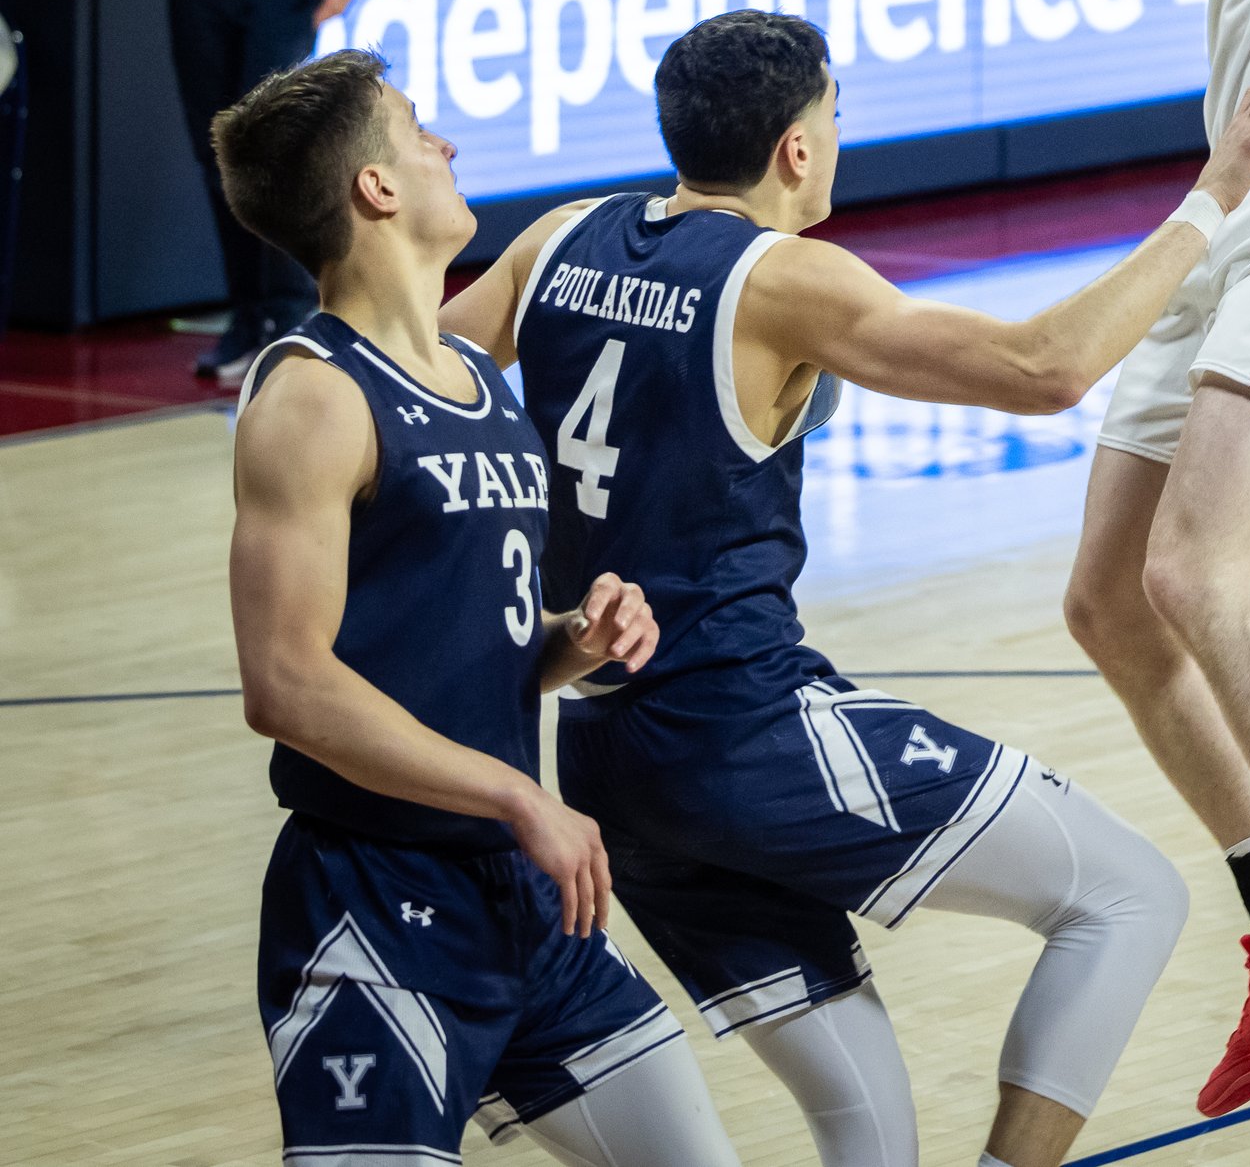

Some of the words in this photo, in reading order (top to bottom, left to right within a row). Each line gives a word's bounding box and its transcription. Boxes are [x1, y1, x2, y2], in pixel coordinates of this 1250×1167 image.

[540, 263, 702, 333] POULAKIDAS
[557, 338, 627, 520] 4
[502, 529, 534, 647] 3
[900, 723, 958, 774] Y
[322, 1053, 377, 1111] Y
